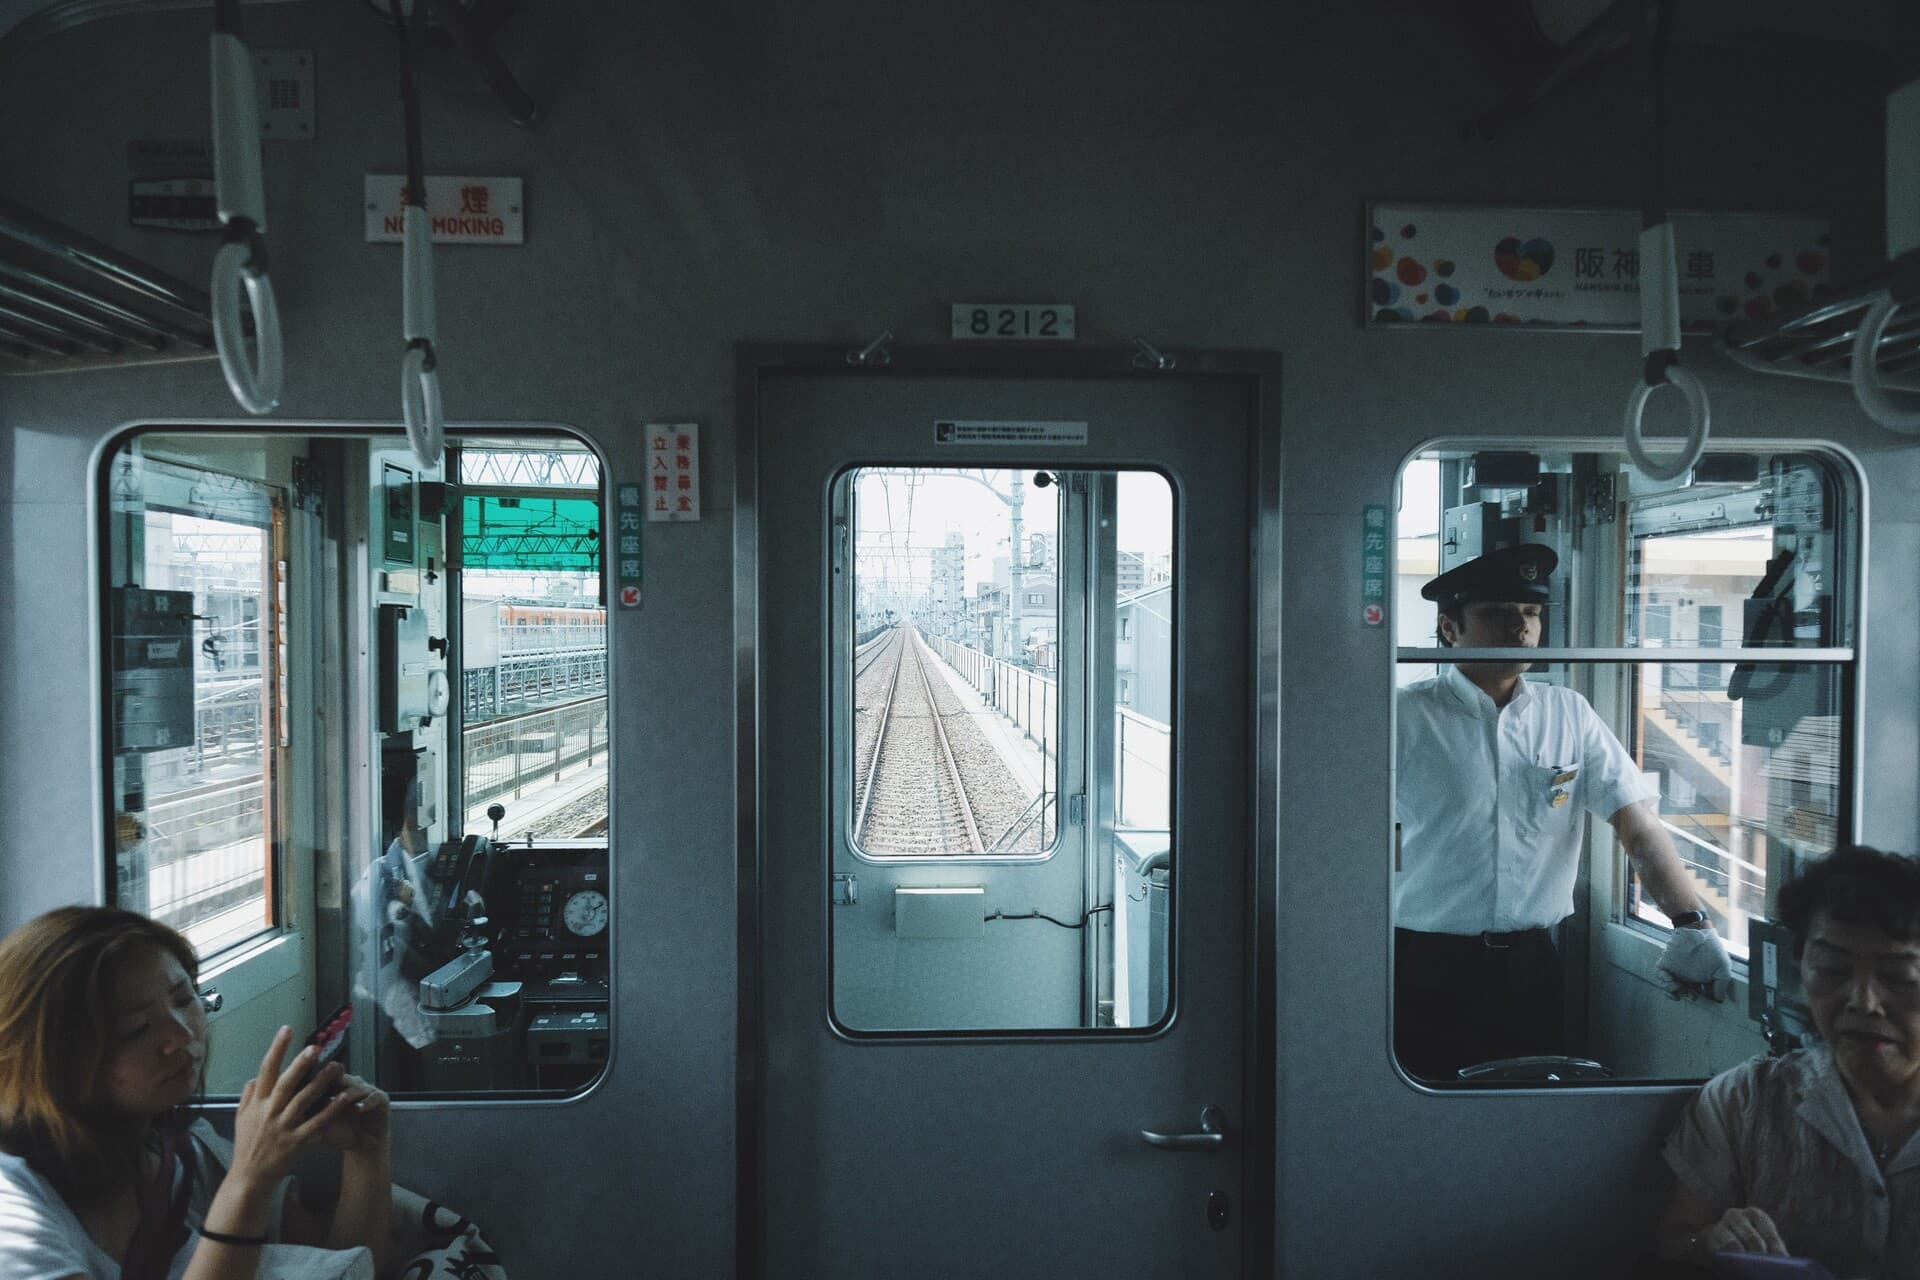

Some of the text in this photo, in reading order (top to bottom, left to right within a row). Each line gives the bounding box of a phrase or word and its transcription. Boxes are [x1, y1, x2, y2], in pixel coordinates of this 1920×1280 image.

[431, 217, 505, 236] MOKING
[1575, 246, 1715, 280] 阪神車
[970, 309, 1059, 336] 8212
[654, 435, 669, 511] 立入禁止
[620, 487, 640, 578] 優先座席
[1365, 508, 1385, 597] 優先座席
